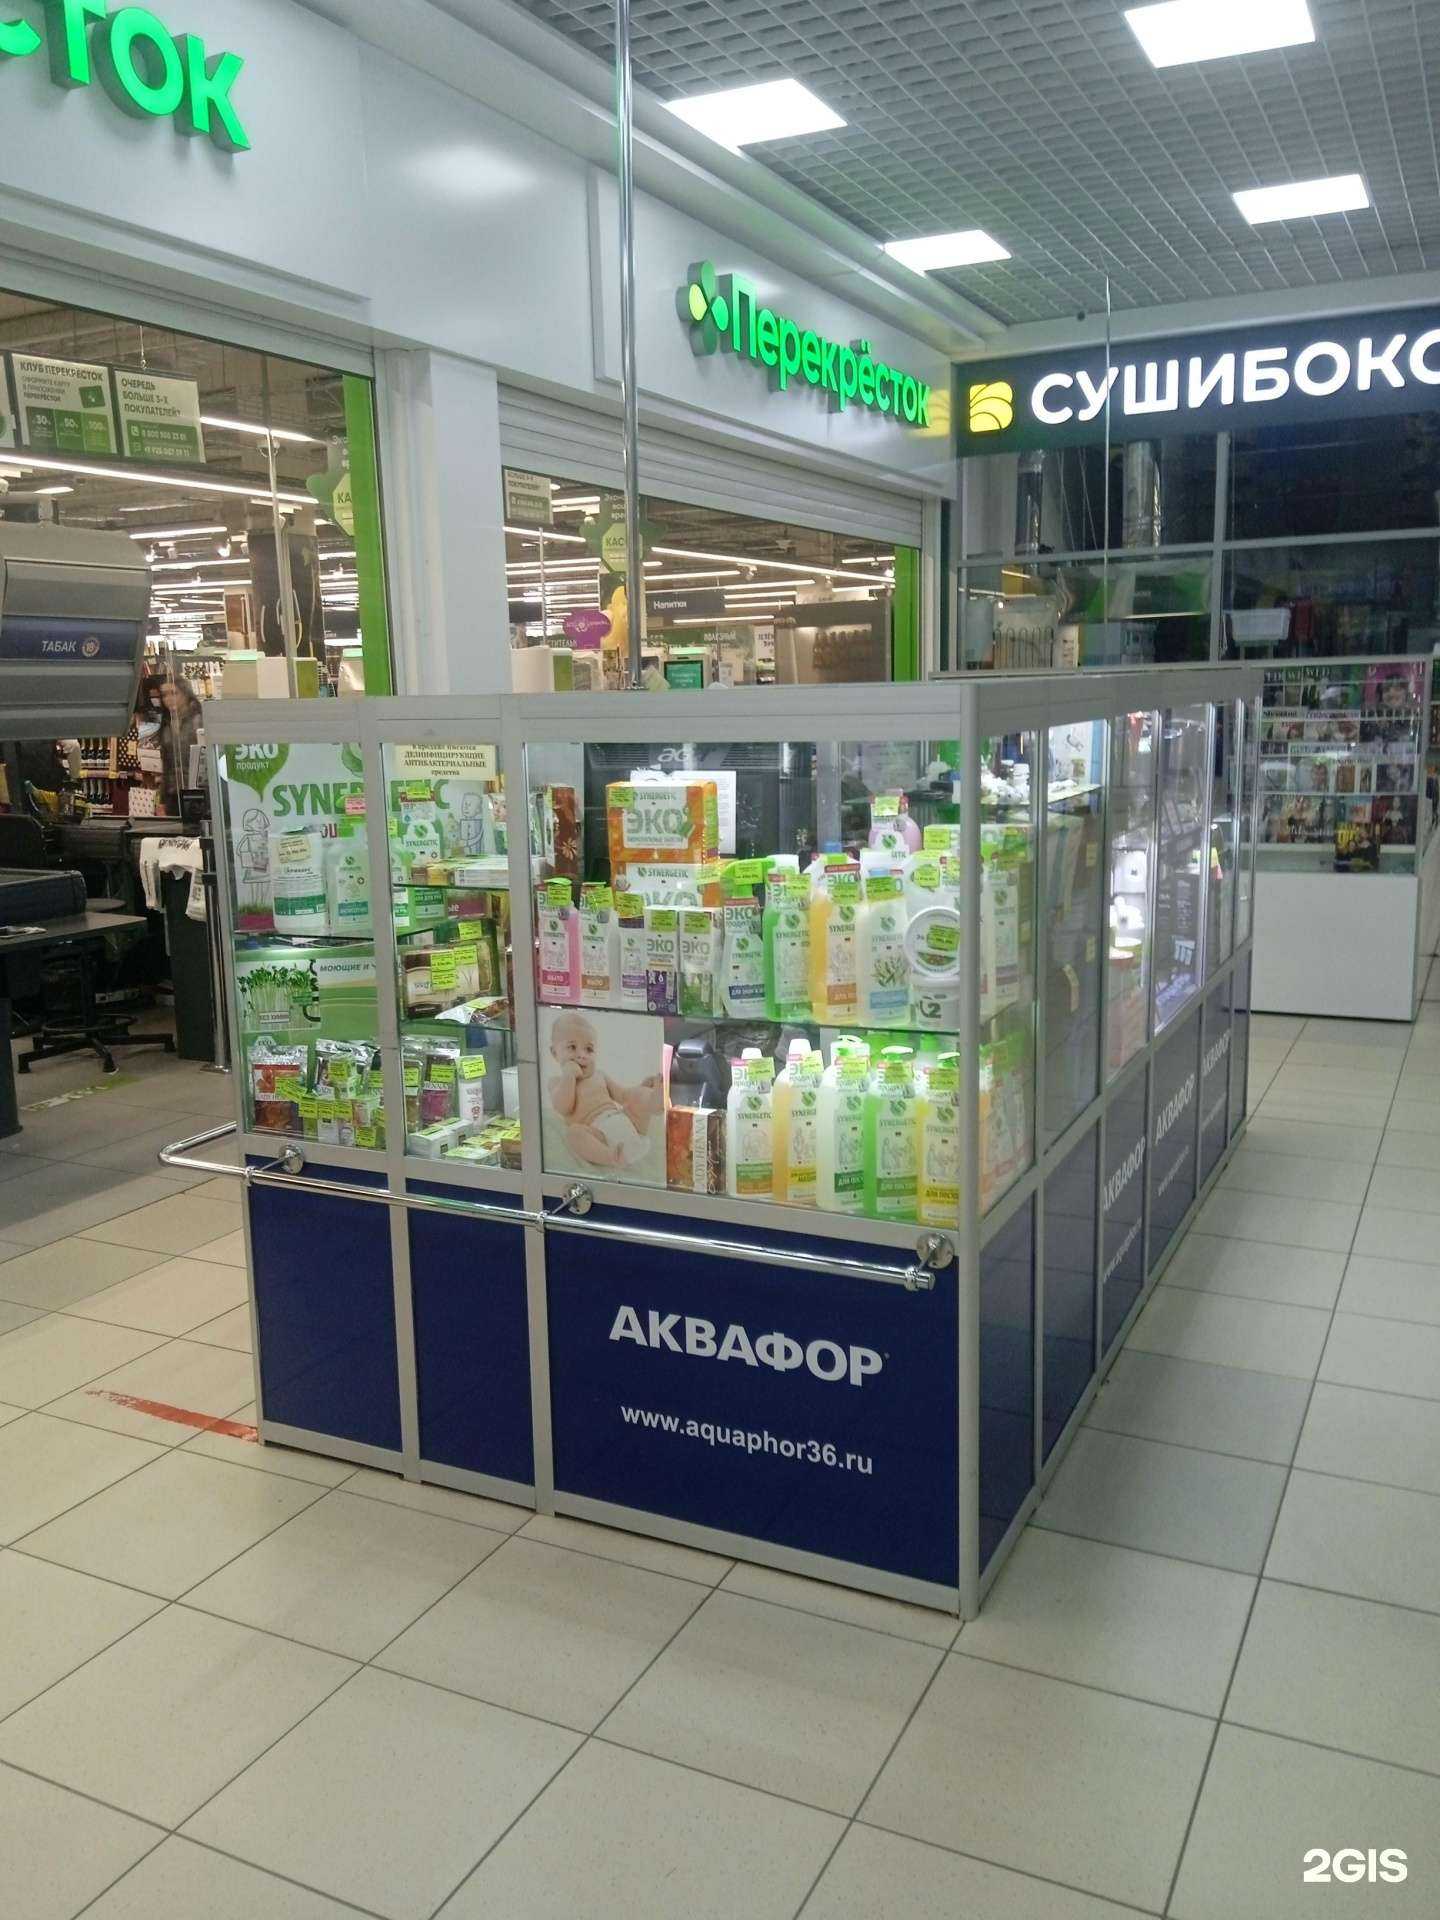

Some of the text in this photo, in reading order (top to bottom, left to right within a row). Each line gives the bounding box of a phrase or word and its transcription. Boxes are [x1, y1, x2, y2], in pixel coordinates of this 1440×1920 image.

[731, 272, 929, 427] Перекрёсток
[20, 361, 44, 373] КЛУБ
[121, 378, 156, 391] ОЧЕРЕДЬ
[122, 390, 155, 403] БОЛЬШЕ
[653, 600, 687, 610] Напитки
[41, 640, 76, 653] ТАБАК
[236, 760, 270, 771] продукт
[431, 769, 460, 777] средства
[626, 808, 683, 835] ЭКО
[726, 906, 752, 920] ЭКО
[646, 938, 675, 953] ЭКО
[682, 940, 710, 955] ЭКО
[1155, 1073, 1196, 1146] АКВАФОР
[608, 1305, 884, 1387] АКВАФОР
[620, 1404, 873, 1475] www.aquaphor36.ru
